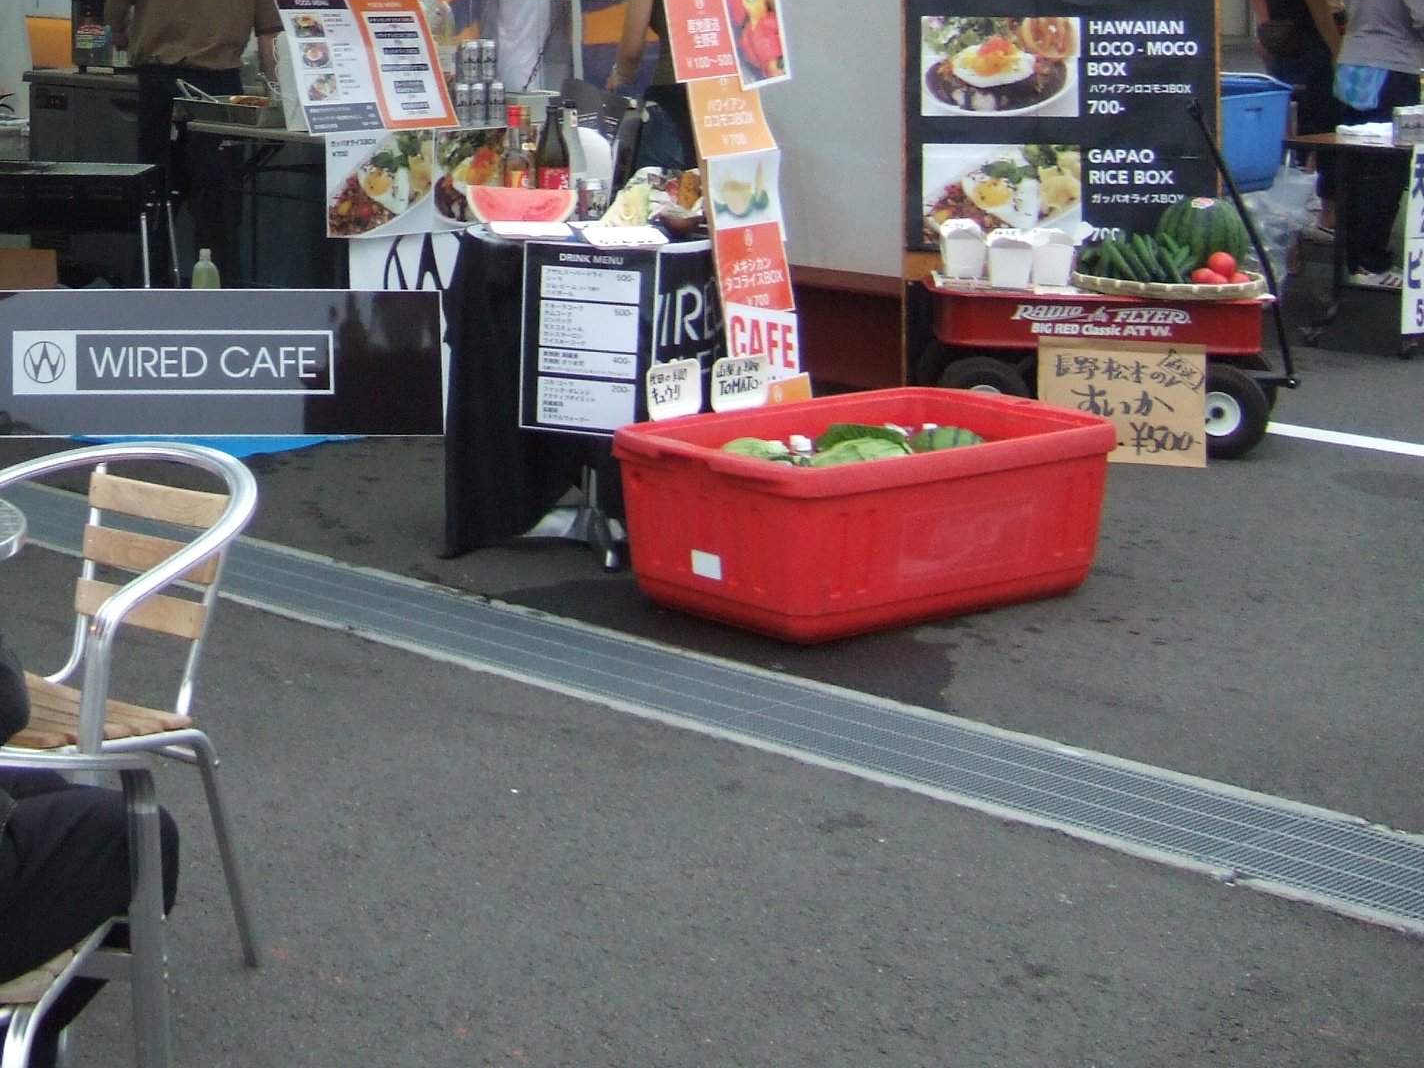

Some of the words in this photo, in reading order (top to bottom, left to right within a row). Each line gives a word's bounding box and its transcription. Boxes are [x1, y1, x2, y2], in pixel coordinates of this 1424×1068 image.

[1089, 21, 1184, 35] HAWAIIAN
[1090, 42, 1133, 56] LOCO
[1147, 42, 1198, 56] MOCO
[1087, 62, 1126, 77] BOX
[1088, 149, 1154, 163] GAPAO
[1089, 170, 1128, 184] RICE
[1134, 170, 1173, 184] BOX
[559, 253, 591, 263] DRINK
[592, 254, 624, 265] MENU
[1031, 323, 1052, 334] BIG
[1055, 324, 1079, 334] RED
[1082, 324, 1121, 336] Classic
[730, 315, 795, 369] CAFE
[88, 346, 207, 378] WIRED
[220, 346, 317, 378] CAFE
